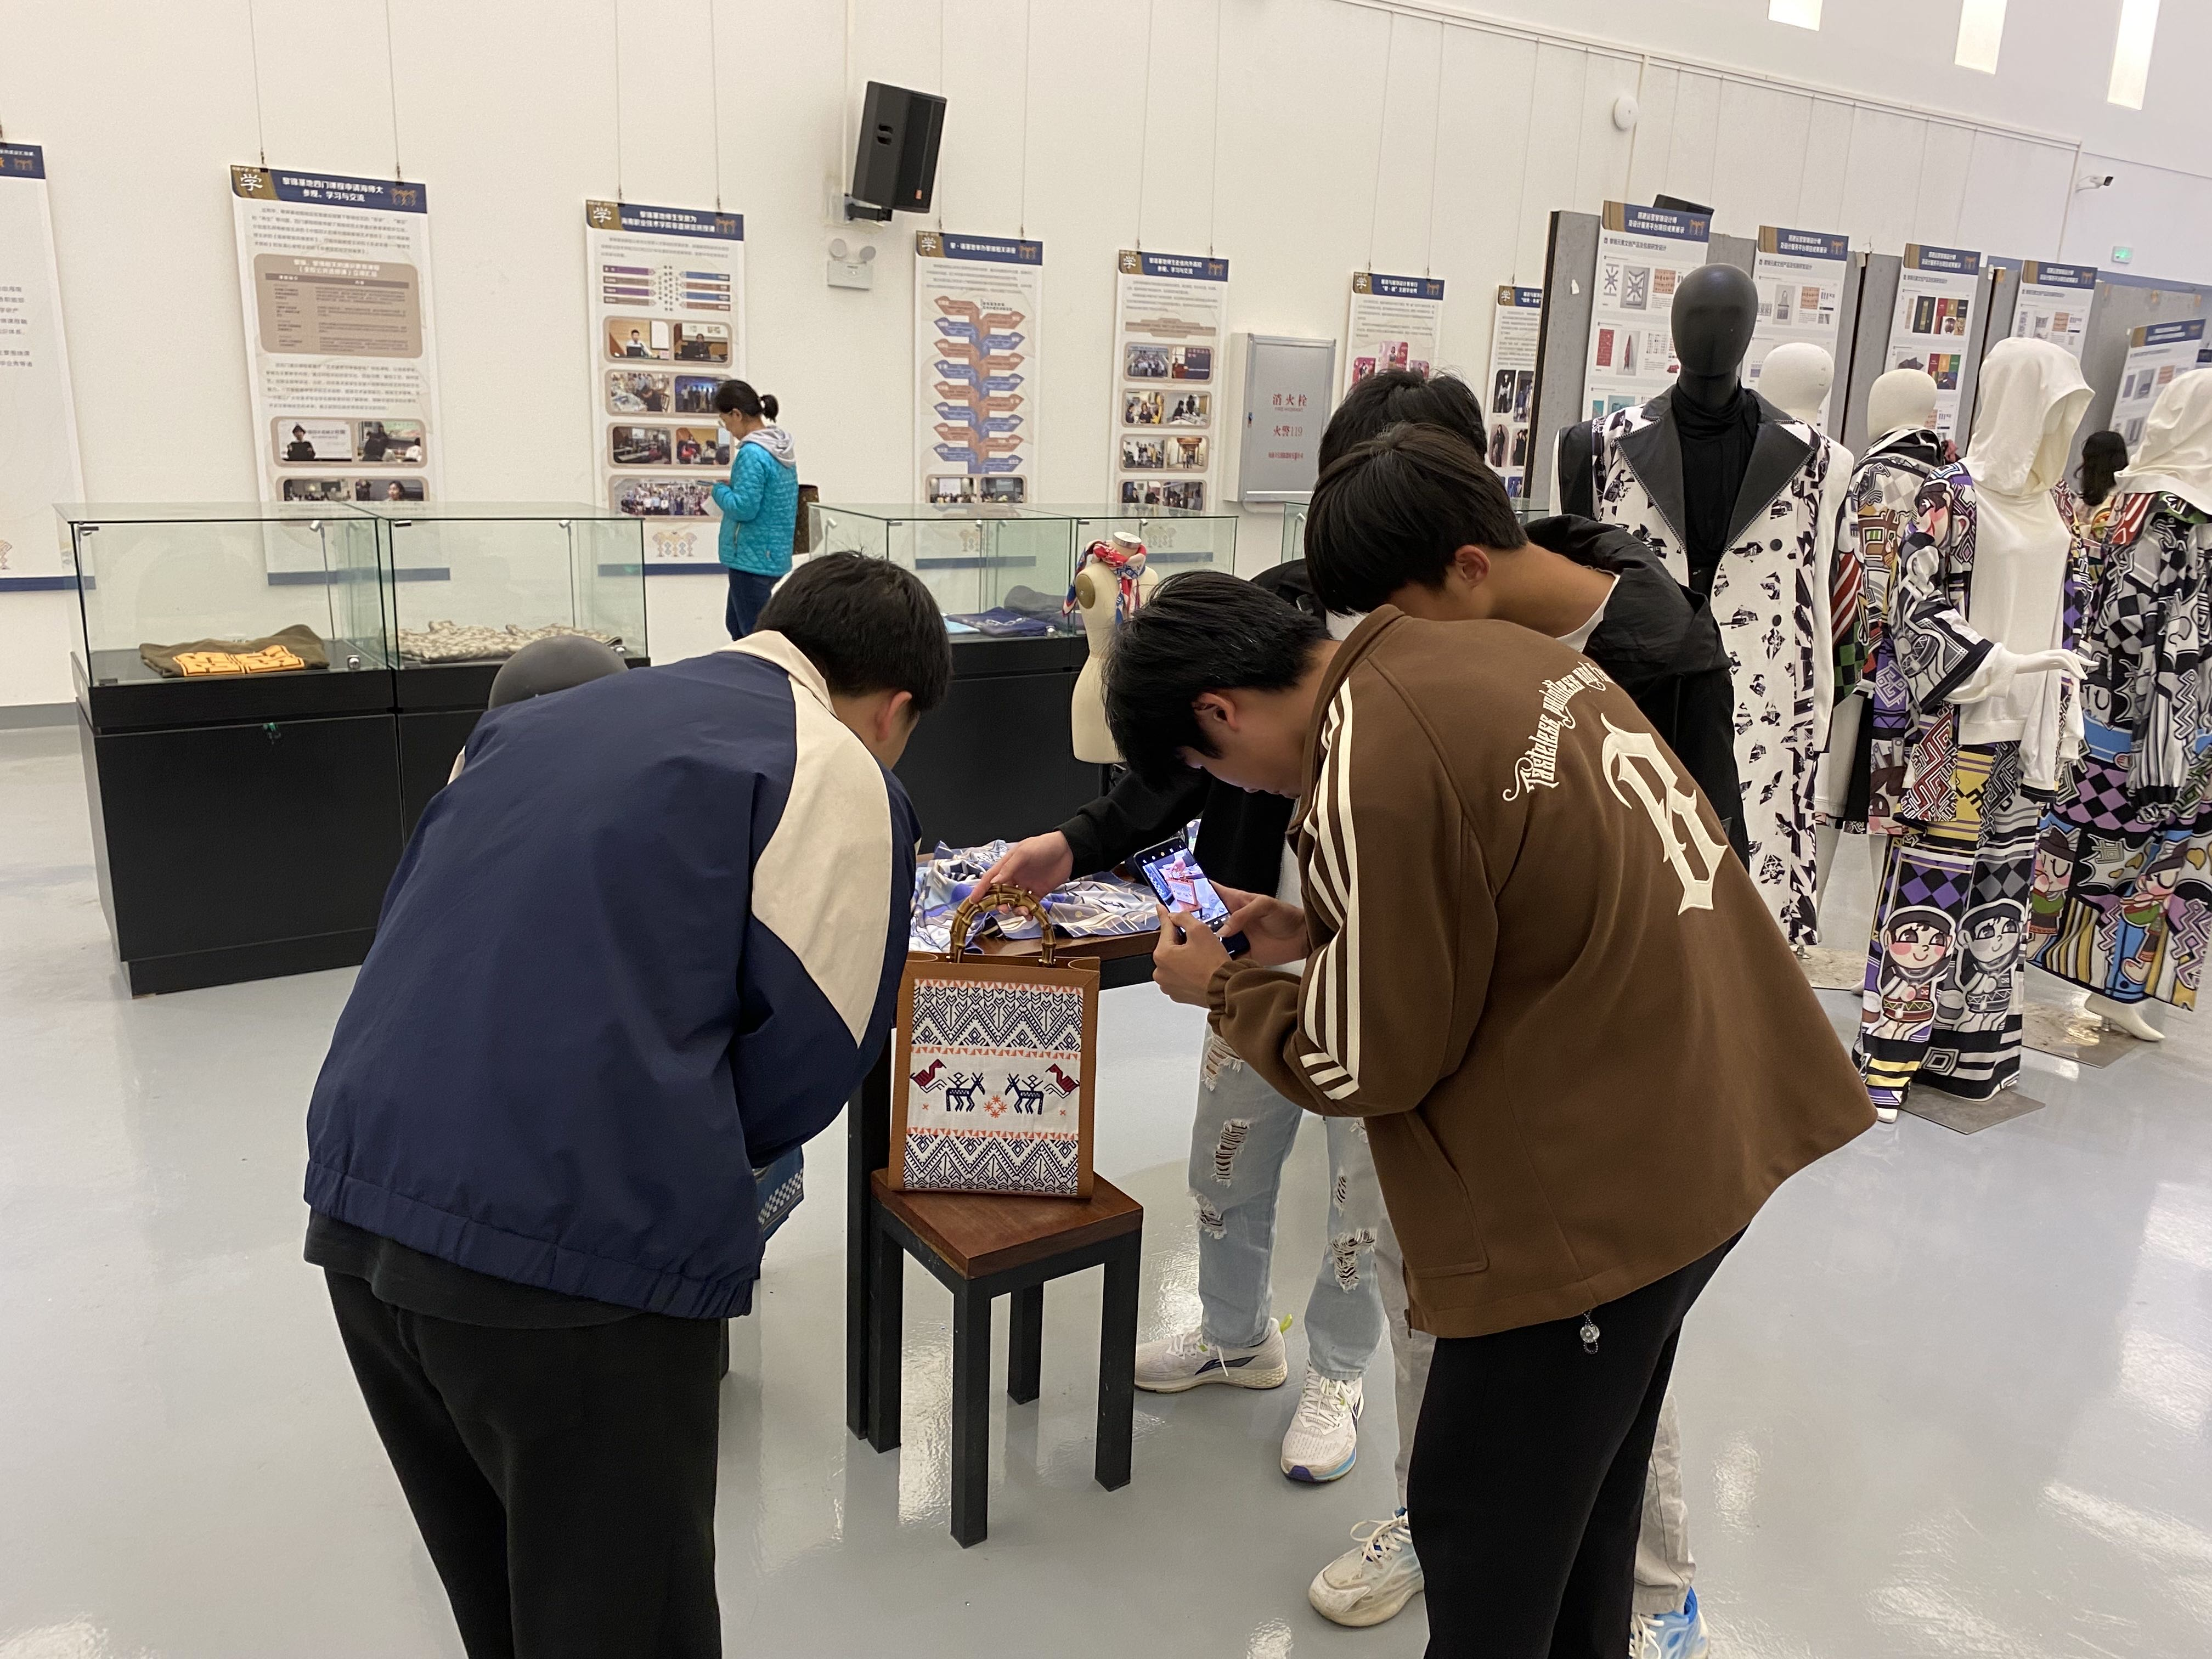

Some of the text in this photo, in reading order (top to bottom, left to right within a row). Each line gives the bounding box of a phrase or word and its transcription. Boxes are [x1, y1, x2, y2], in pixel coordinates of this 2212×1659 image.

[240, 173, 263, 192] 学
[593, 207, 612, 223] 学
[922, 236, 936, 251] 学
[1272, 393, 1308, 407] 消火栓
[1273, 425, 1303, 437] 火警119
